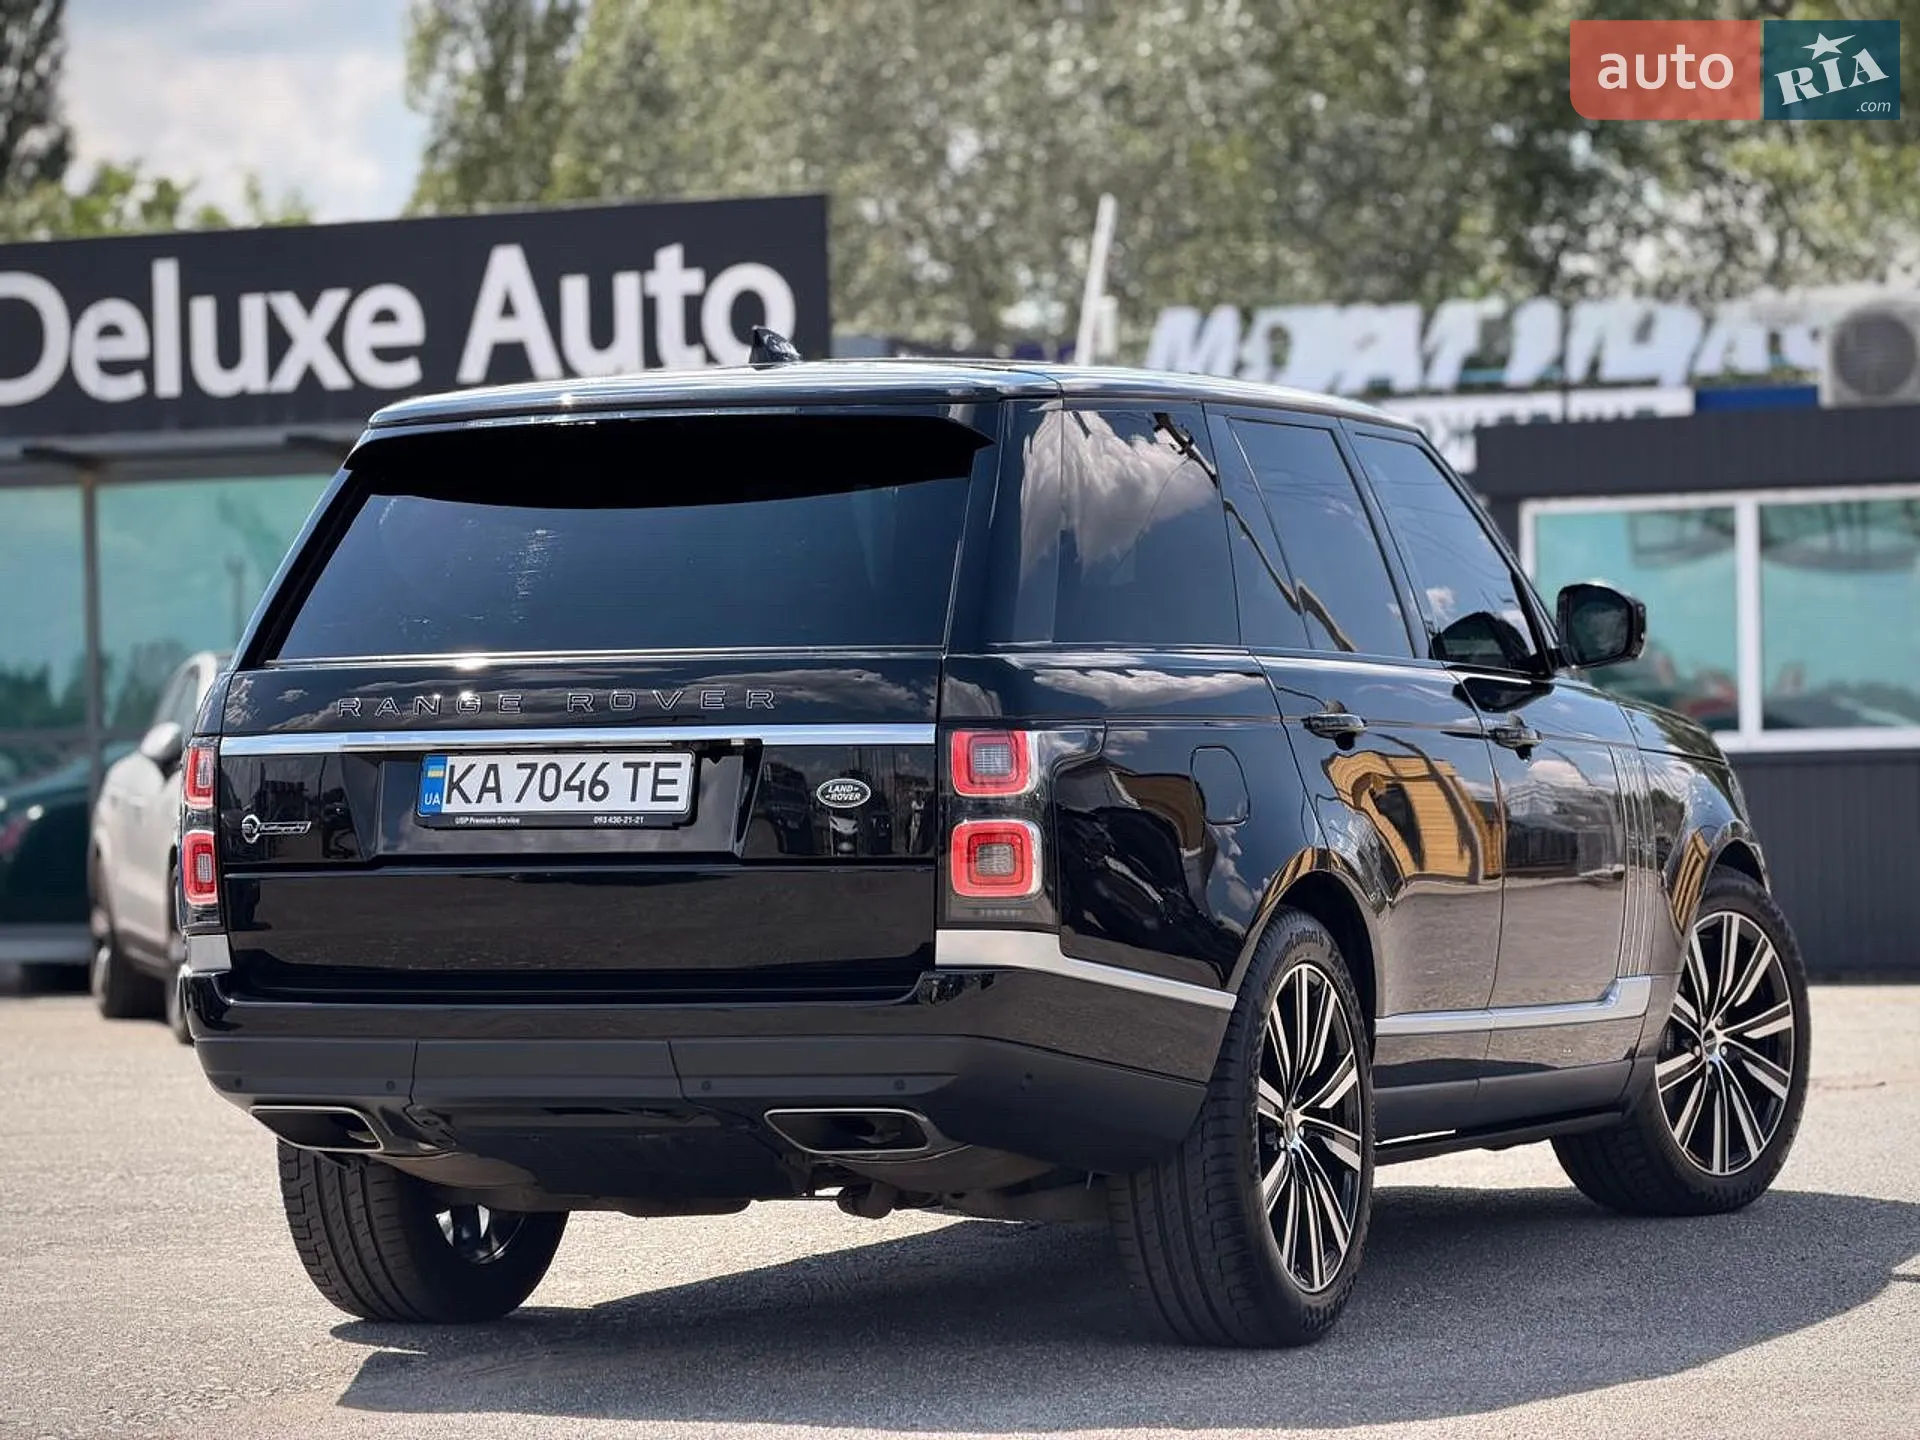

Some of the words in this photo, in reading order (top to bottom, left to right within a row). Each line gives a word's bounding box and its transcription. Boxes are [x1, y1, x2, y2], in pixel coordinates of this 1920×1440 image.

[0, 257, 426, 408] Deluxe
[457, 243, 796, 385] Auto
[338, 694, 523, 717] RANGE
[567, 689, 775, 712] ROVER
[424, 793, 441, 806] UA
[446, 763, 503, 804] KA
[515, 762, 610, 803] 7046
[622, 762, 682, 802] TE
